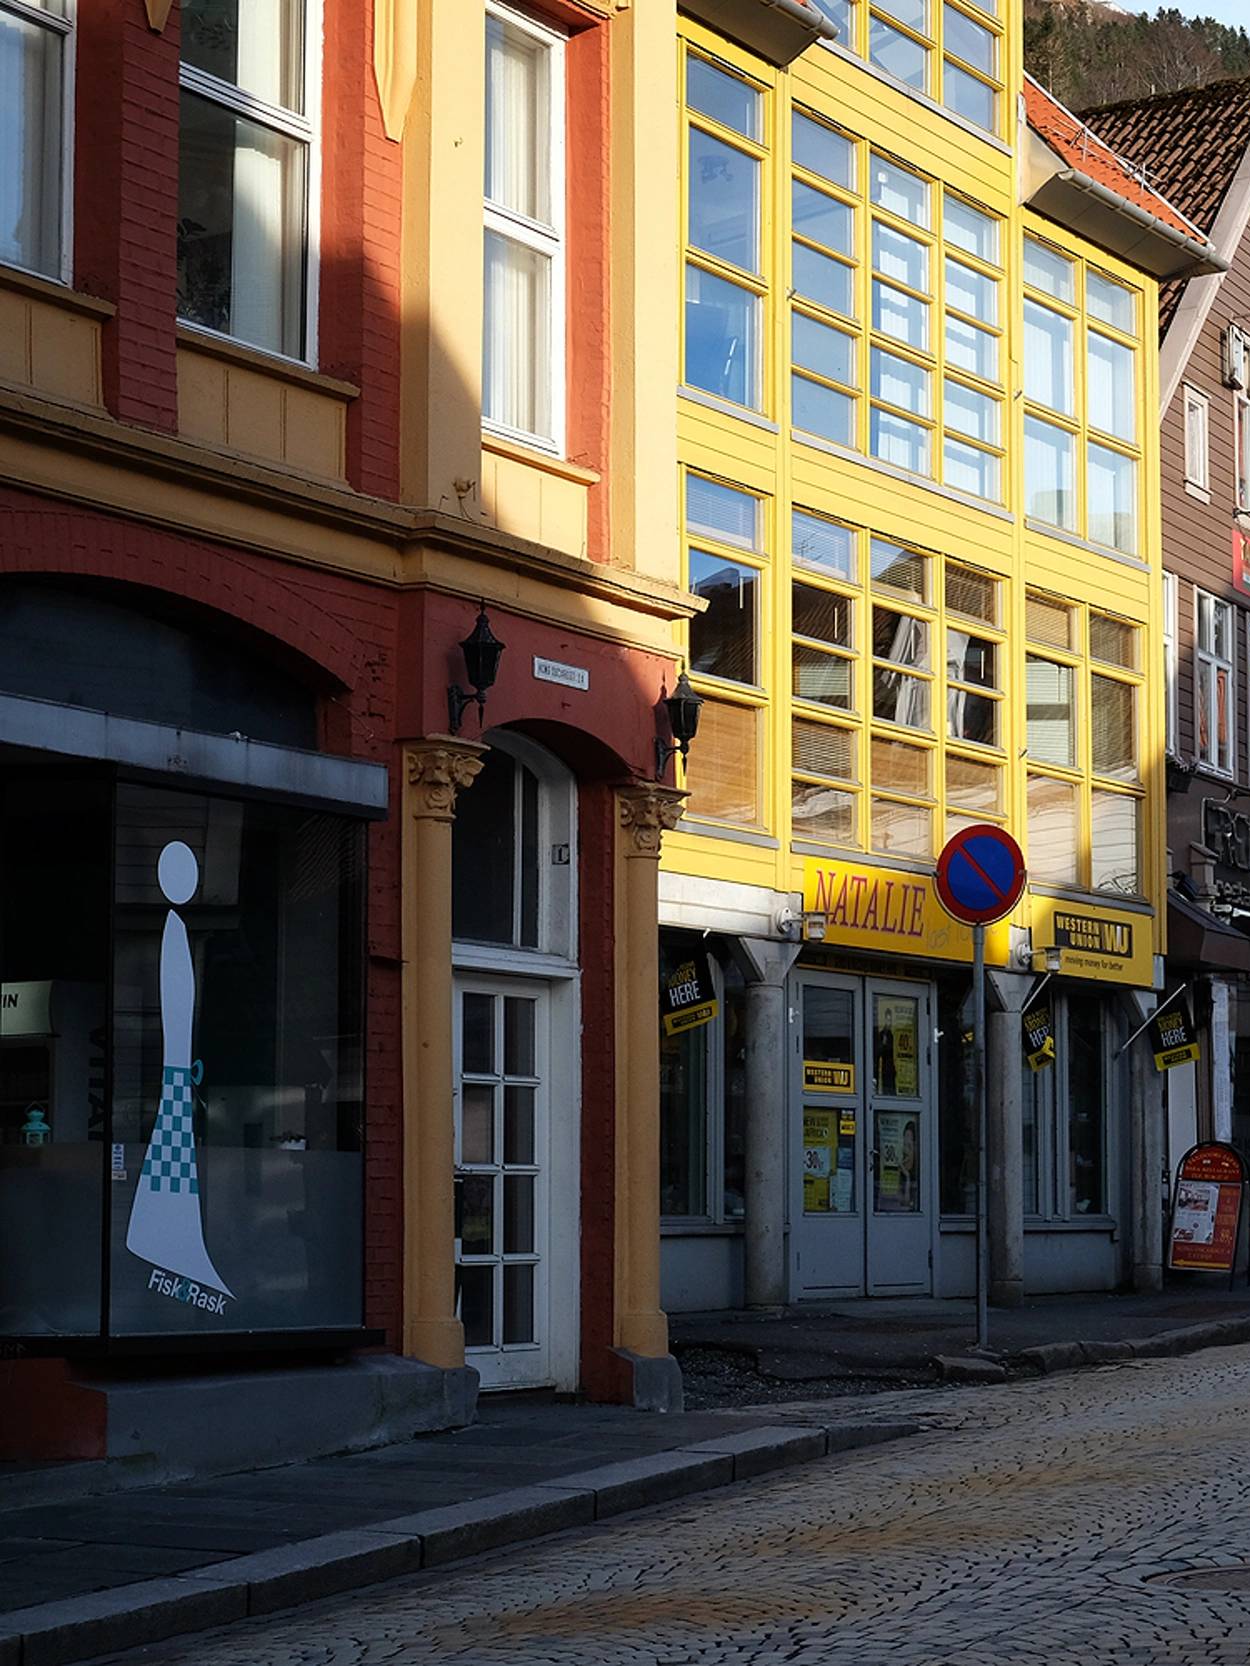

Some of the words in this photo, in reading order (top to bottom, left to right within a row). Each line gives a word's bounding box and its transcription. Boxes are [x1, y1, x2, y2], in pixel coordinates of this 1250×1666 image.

[814, 869, 926, 937] NATALIE
[1056, 915, 1100, 936] WESTERN
[1070, 932, 1101, 949] UNION
[1108, 961, 1123, 972] better
[669, 980, 701, 1008] HERE
[1029, 1024, 1051, 1049] HER
[1161, 1026, 1188, 1048] HERE
[806, 1068, 833, 1077] WESTERN
[814, 1076, 833, 1084] UNION
